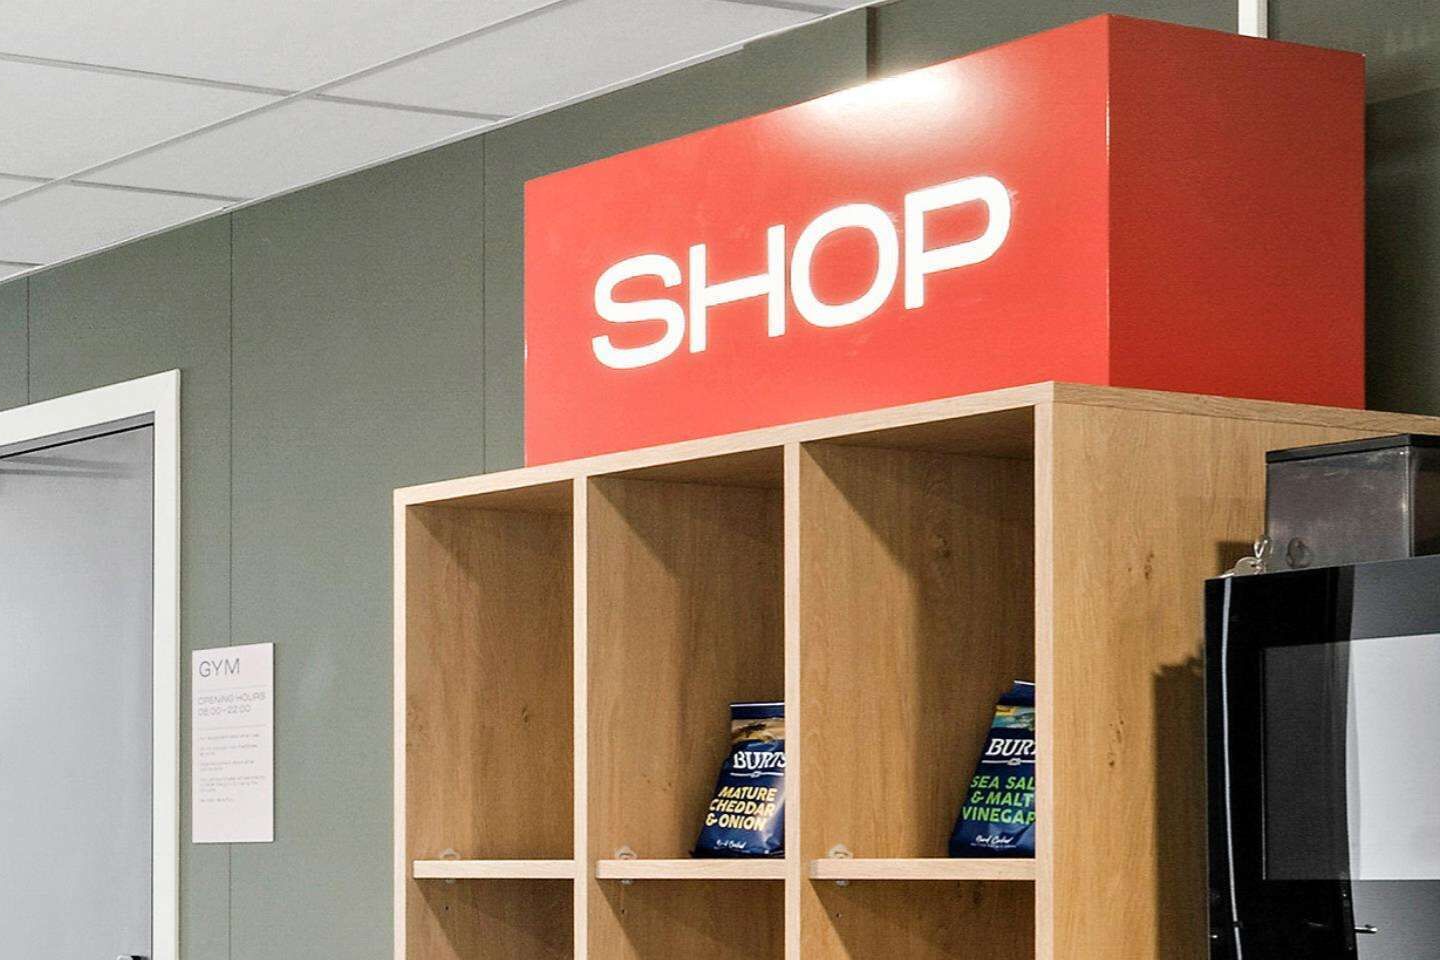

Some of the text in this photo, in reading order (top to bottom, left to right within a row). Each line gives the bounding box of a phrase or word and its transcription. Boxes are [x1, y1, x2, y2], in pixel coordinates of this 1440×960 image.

[592, 176, 1013, 371] SHOP
[198, 657, 241, 678] GYM
[971, 775, 999, 790] SEA
[718, 786, 777, 802] MATURE
[971, 791, 1035, 807] & MALT
[709, 799, 776, 817] CHEDDAR
[705, 813, 767, 832] & ONION
